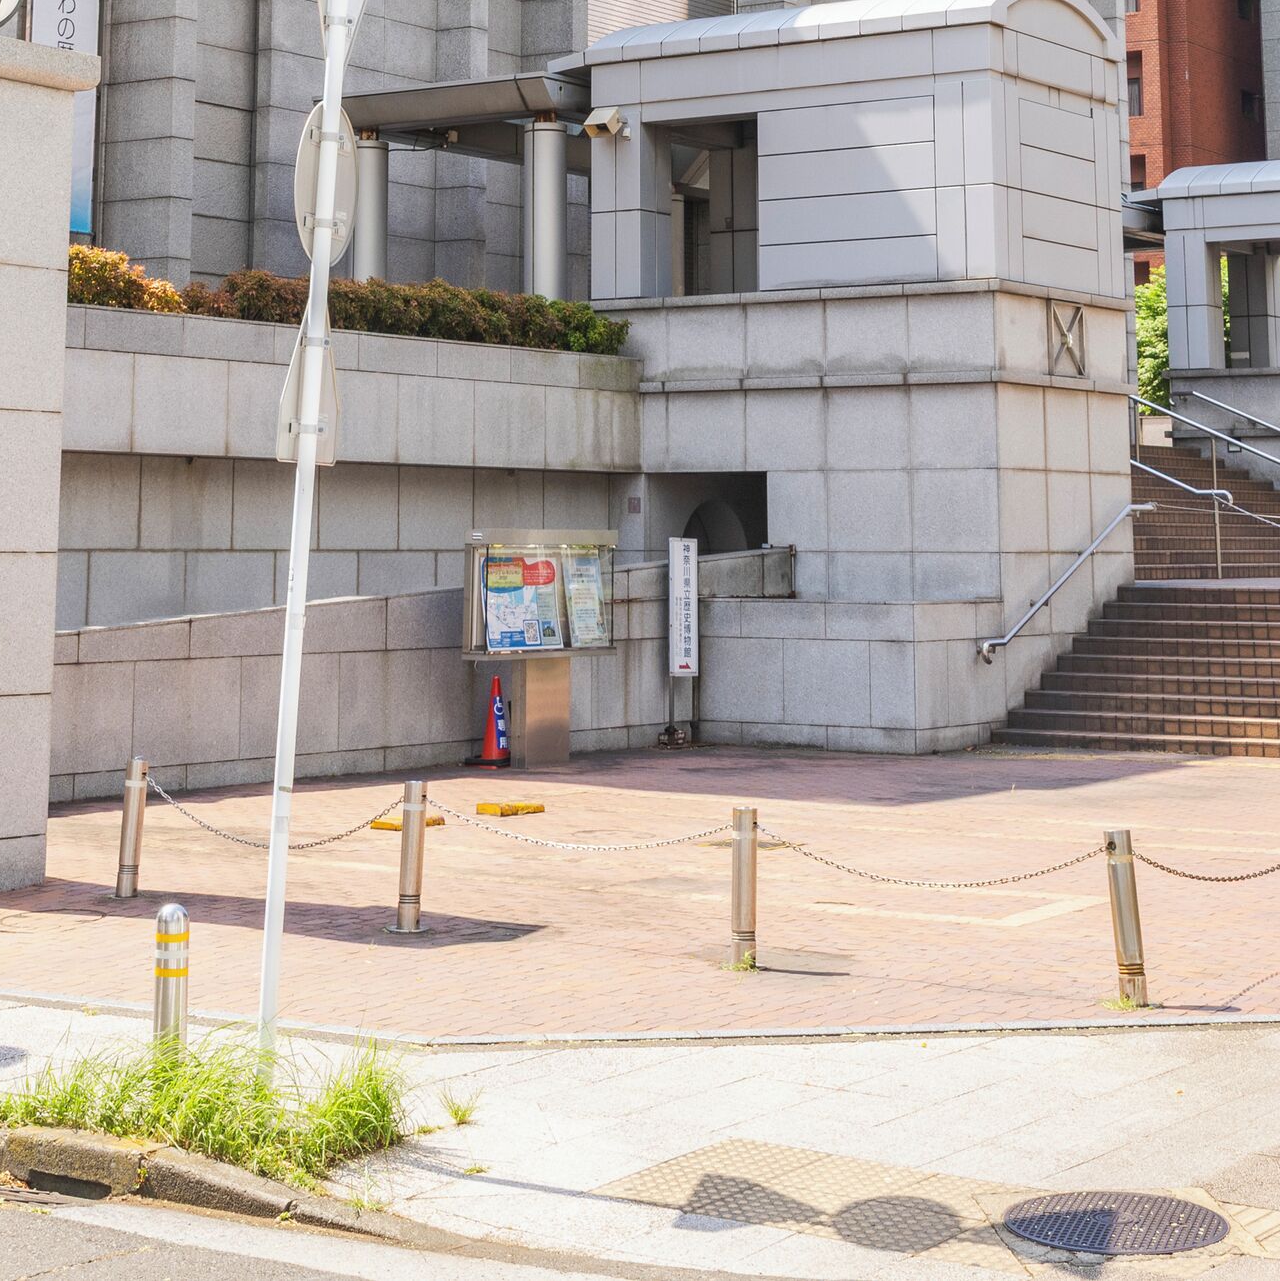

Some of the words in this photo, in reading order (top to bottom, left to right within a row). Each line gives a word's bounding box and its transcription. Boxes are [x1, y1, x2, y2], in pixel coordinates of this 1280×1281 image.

[682, 544, 692, 658] 神奈川県立歴史博物館
